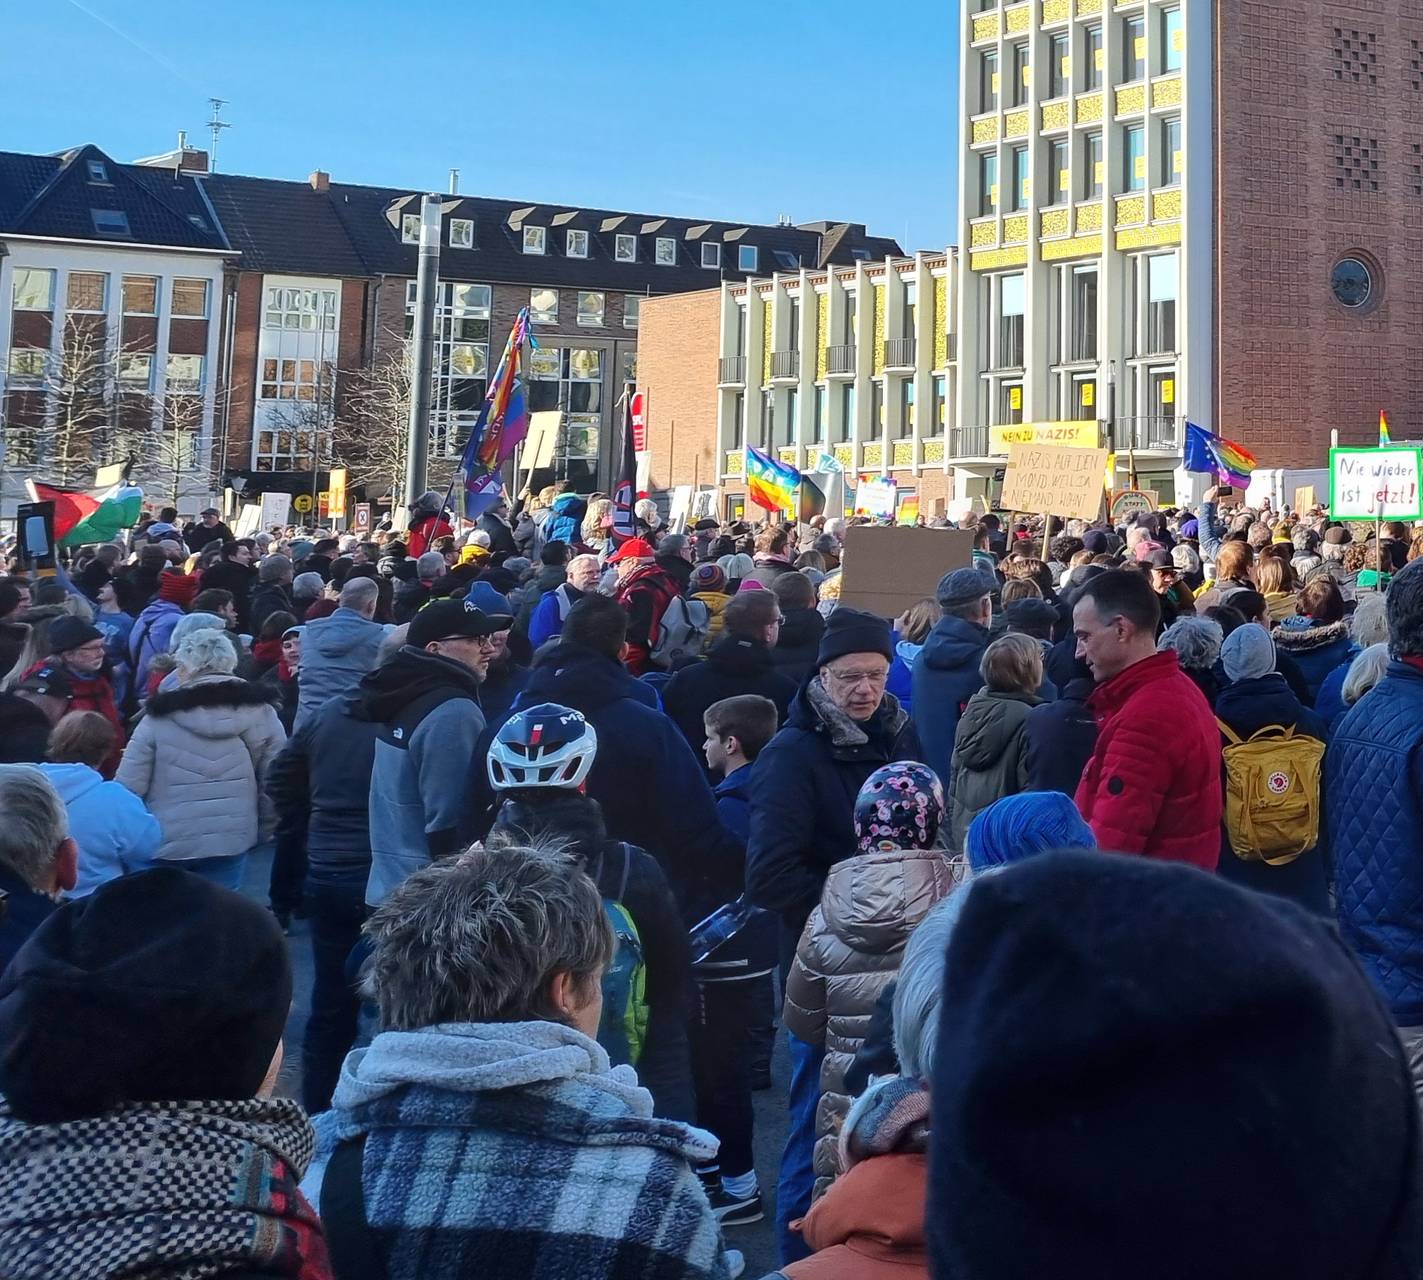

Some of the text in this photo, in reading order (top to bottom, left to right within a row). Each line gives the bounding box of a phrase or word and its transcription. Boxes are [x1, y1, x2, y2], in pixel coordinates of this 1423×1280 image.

[1002, 428, 1079, 442] NEIN ZU NAZIS!
[1019, 450, 1050, 470] NAZIS
[1054, 454, 1072, 471] AUF
[1340, 458, 1413, 477] Nie wieder
[1010, 489, 1054, 506] NIEMAND
[1341, 482, 1415, 514] ist jetzt!
